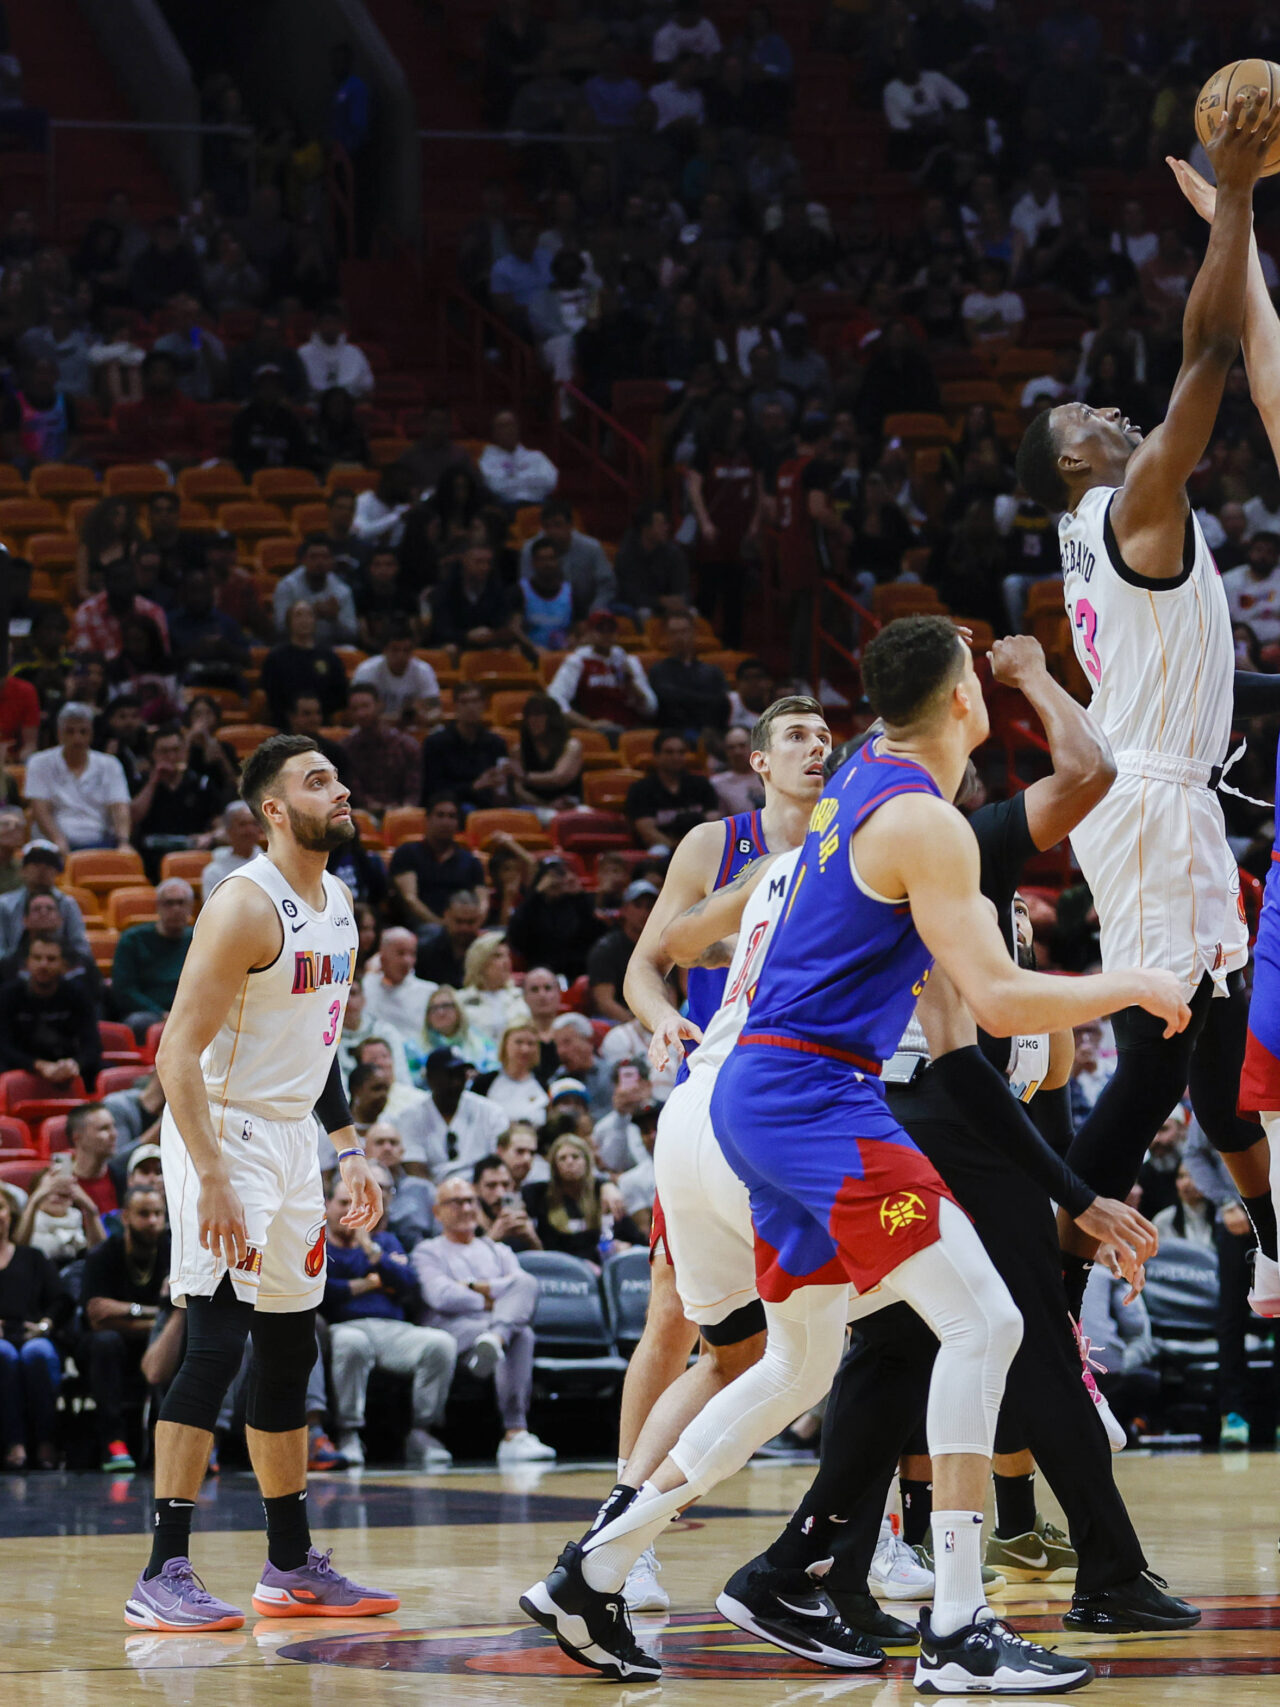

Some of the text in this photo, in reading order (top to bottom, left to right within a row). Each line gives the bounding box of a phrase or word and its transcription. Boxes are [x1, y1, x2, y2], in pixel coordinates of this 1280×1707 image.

[739, 839, 751, 853] 6
[284, 901, 297, 917] 6
[323, 999, 344, 1046] 3
